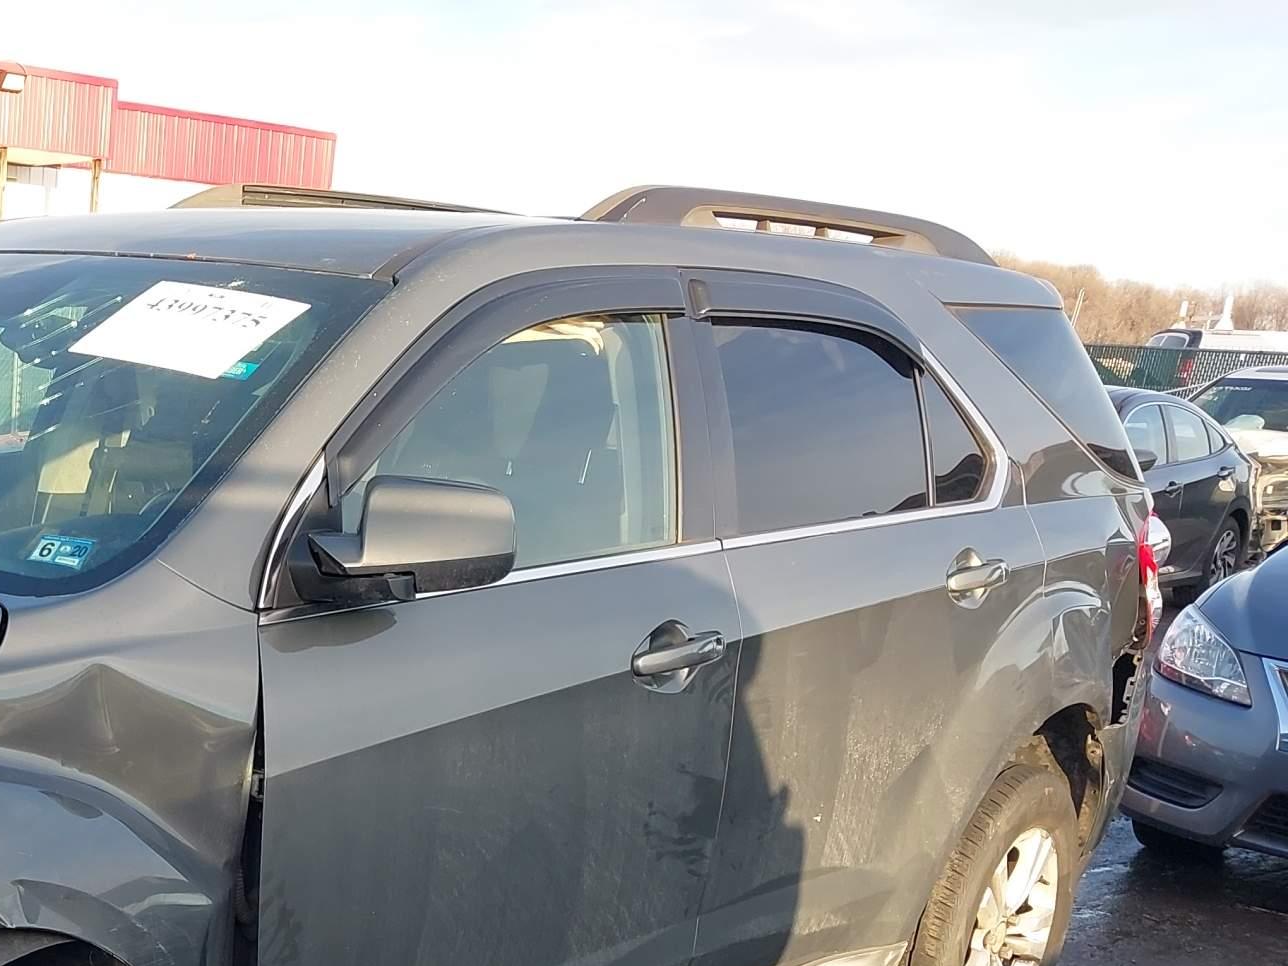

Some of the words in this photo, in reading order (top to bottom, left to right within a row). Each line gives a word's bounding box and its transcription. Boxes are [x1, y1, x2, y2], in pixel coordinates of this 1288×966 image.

[146, 297, 268, 328] 43997375
[39, 542, 56, 558] 6
[70, 545, 89, 558] 20
